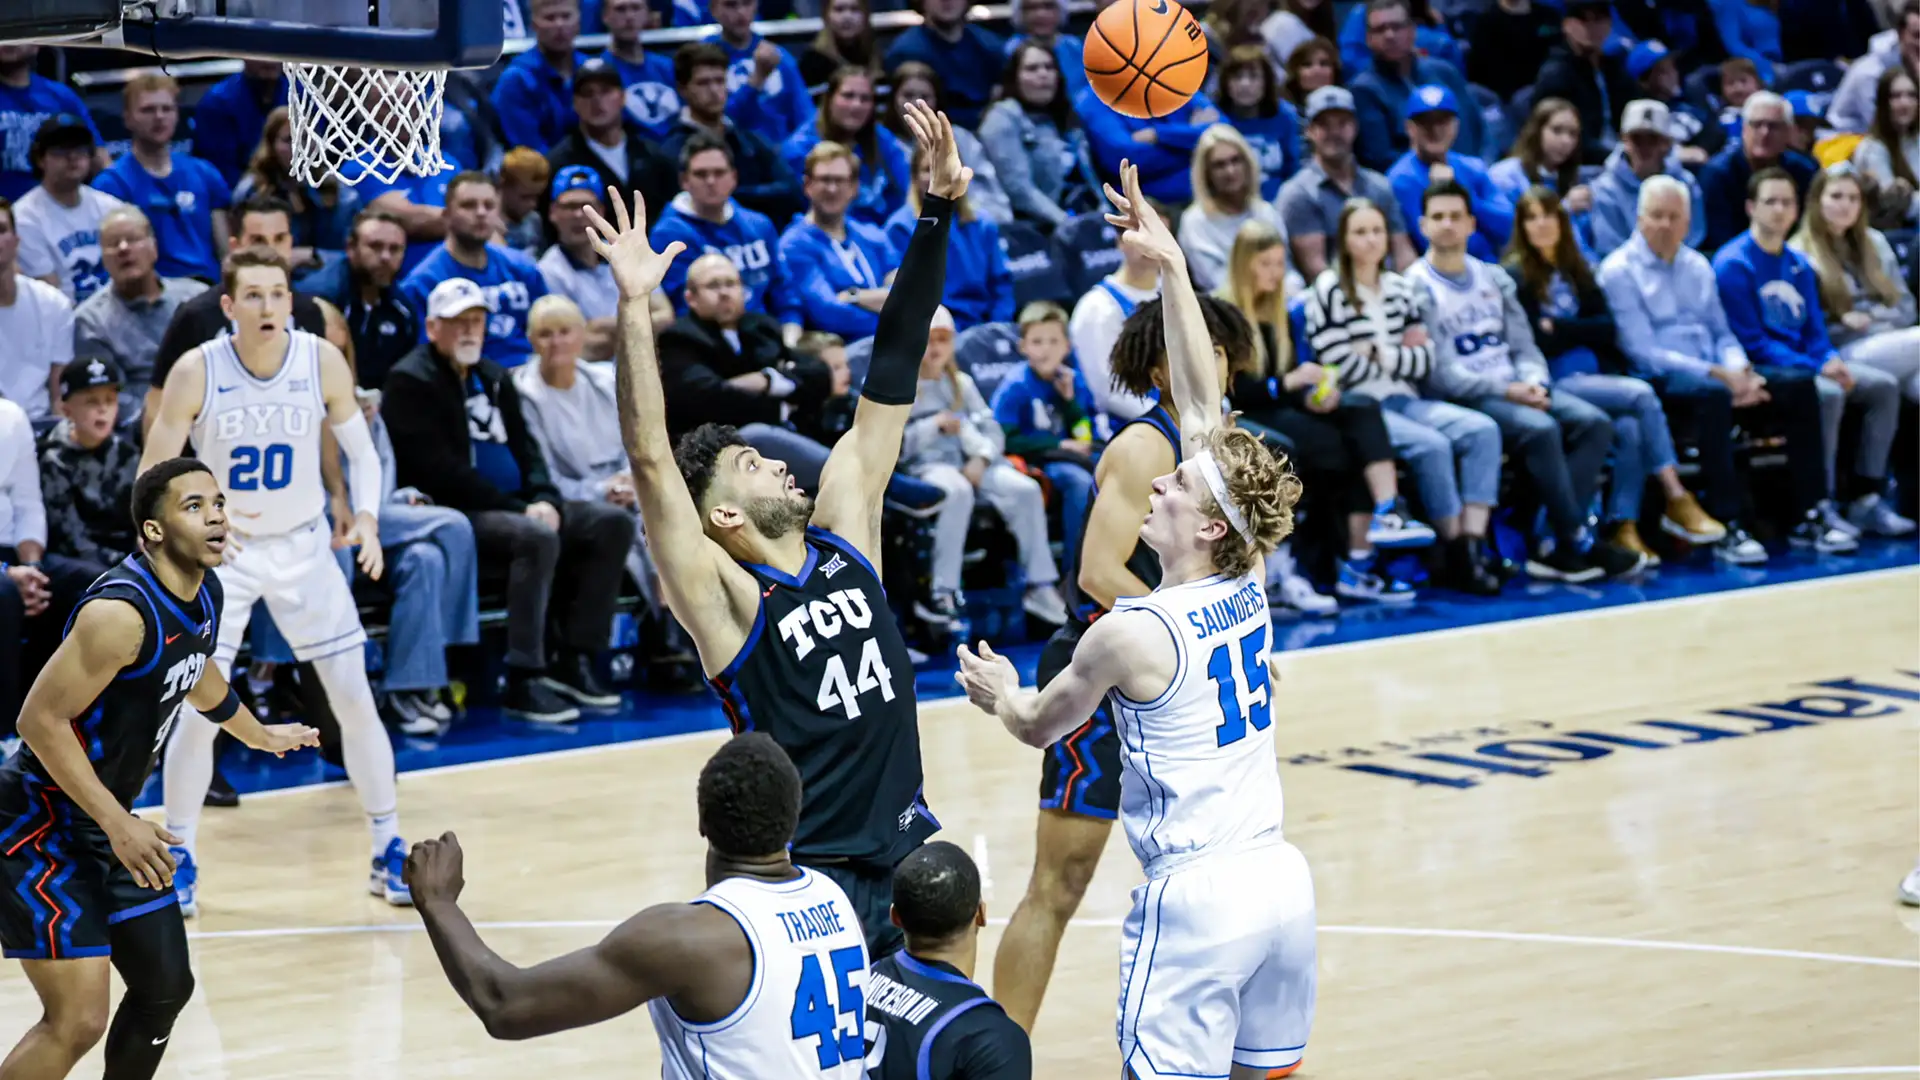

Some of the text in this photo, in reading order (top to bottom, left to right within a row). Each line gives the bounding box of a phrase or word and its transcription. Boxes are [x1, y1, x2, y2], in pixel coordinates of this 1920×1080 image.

[704, 240, 770, 271] YU
[216, 403, 312, 440] BYU
[229, 443, 294, 491] 20
[777, 588, 873, 661] TCU
[1187, 581, 1265, 640] SAUNDERS
[816, 637, 896, 720] 44
[1207, 623, 1272, 748] 15
[776, 900, 845, 943] TRAORE
[790, 944, 865, 1072] 45
[866, 971, 939, 1026] NDERSON III
